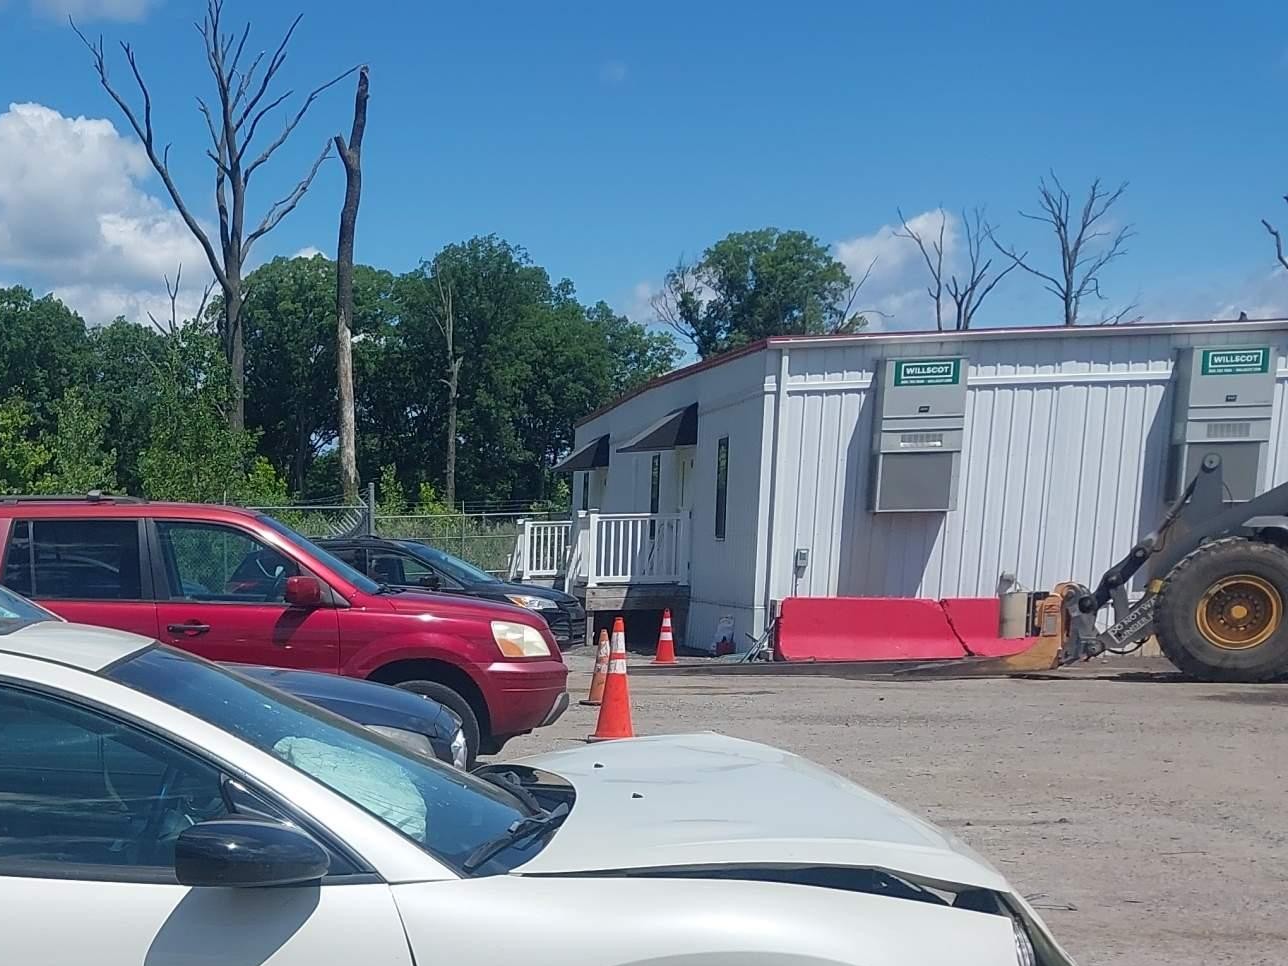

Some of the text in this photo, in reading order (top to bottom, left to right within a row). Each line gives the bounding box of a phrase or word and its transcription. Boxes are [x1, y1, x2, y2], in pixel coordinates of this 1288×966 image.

[1214, 355, 1259, 363] WILLSCOT
[906, 366, 949, 374] WILLSCOT
[1123, 609, 1141, 625] NOT
